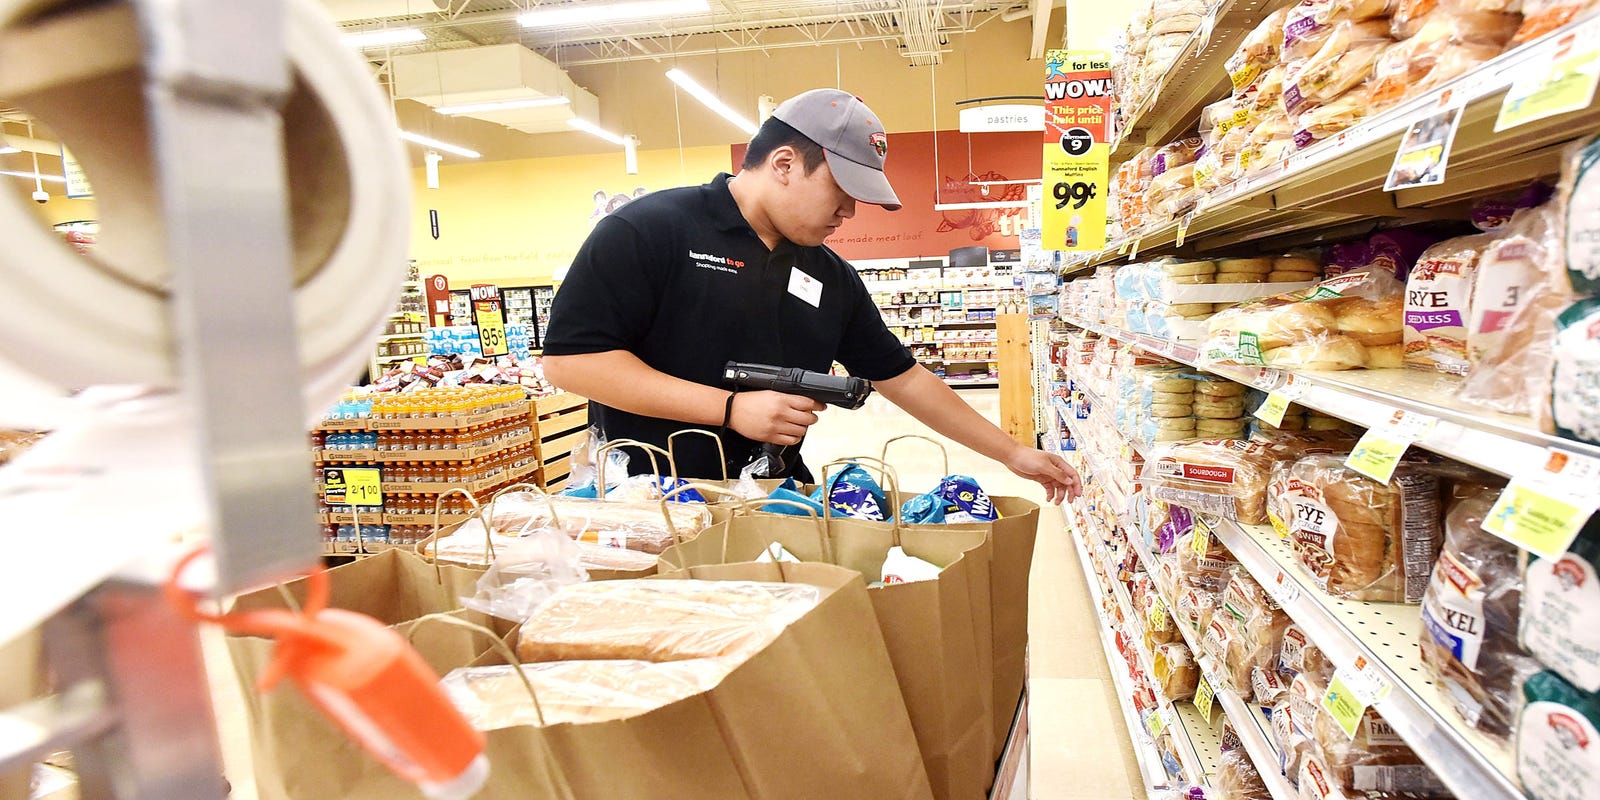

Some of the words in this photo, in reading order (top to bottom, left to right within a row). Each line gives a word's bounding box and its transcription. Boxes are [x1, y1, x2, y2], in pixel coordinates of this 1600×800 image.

[1072, 62, 1087, 70] for
[1090, 61, 1110, 69] less
[1045, 78, 1112, 100] WOW!
[1052, 106, 1075, 115] This
[1077, 105, 1104, 116] price
[987, 114, 1029, 124] pastries
[1052, 115, 1075, 124] held
[1077, 115, 1102, 124] until
[1071, 139, 1083, 151] 9
[1053, 182, 1097, 210] 99¢
[824, 237, 844, 246] ome
[847, 234, 873, 245] made
[875, 233, 900, 244] meat
[726, 257, 735, 266] to
[734, 260, 745, 268] go
[470, 286, 500, 301] WOW!
[1408, 290, 1449, 308] RYE
[1189, 467, 1228, 478] SOURDOUGH
